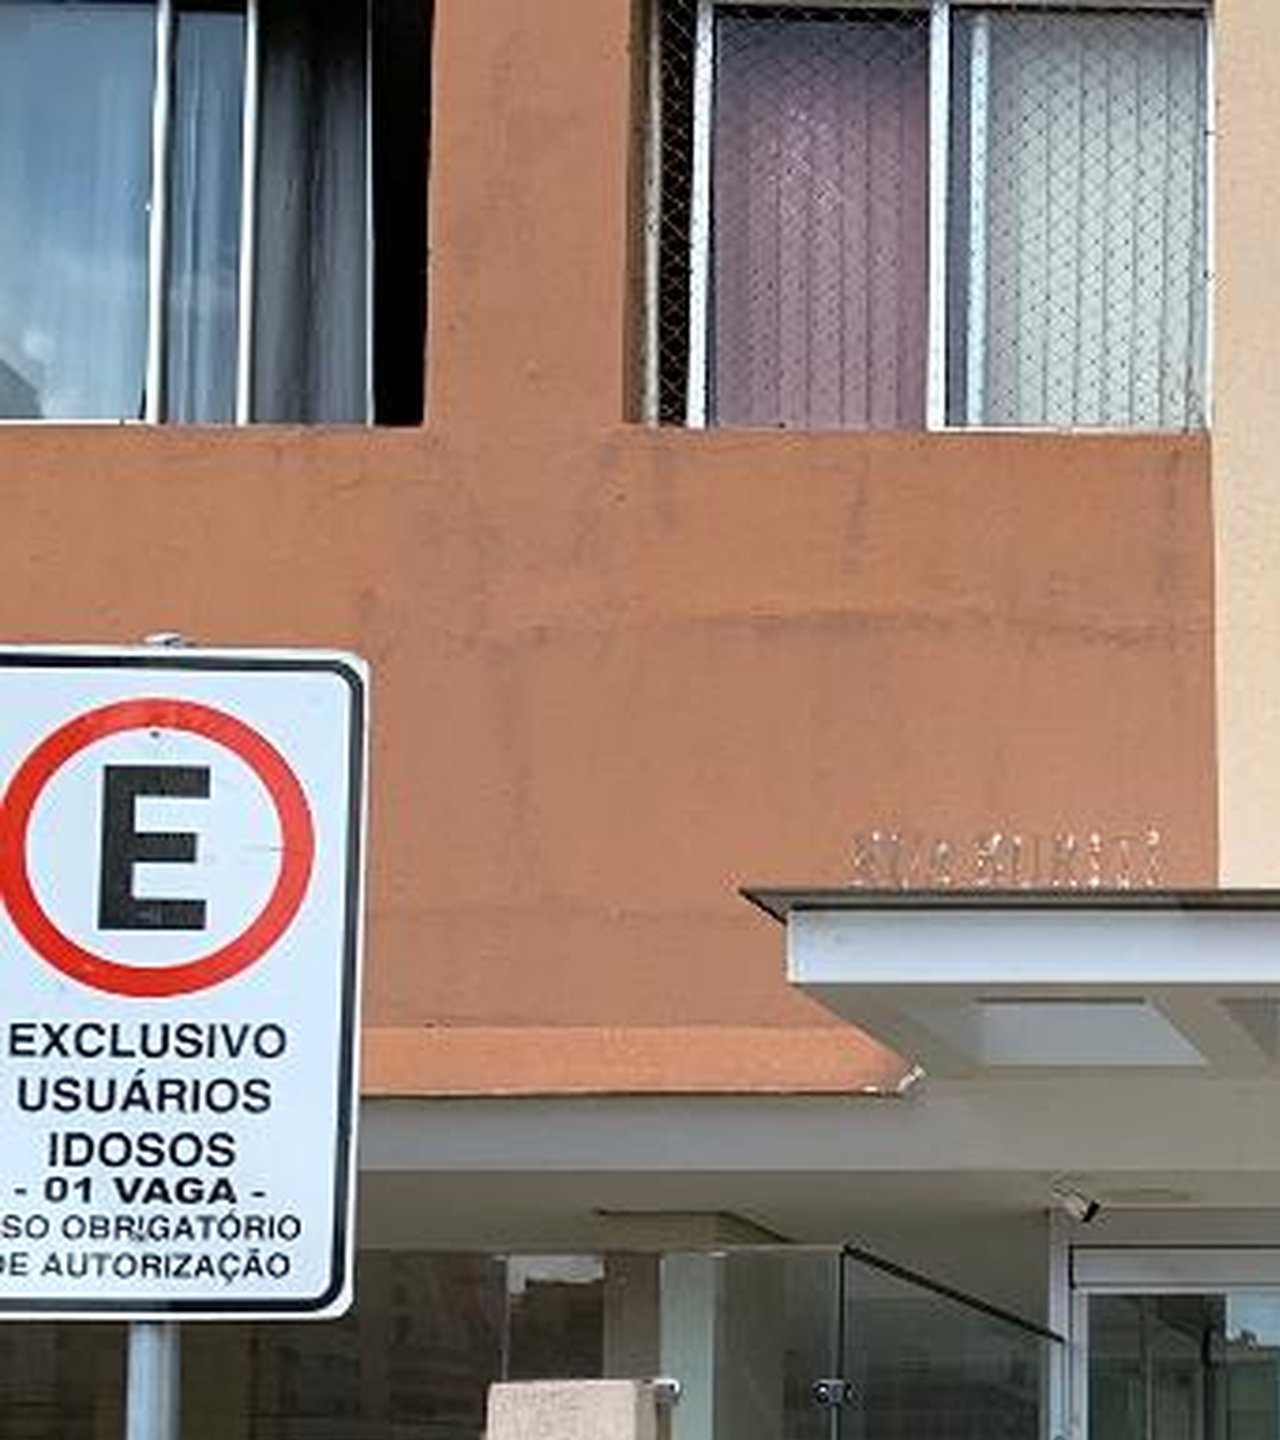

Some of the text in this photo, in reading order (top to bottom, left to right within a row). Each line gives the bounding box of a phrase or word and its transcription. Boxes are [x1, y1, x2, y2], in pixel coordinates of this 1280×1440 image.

[97, 764, 211, 931] E
[9, 1022, 287, 1058] EXCLUSIVO
[18, 1068, 272, 1113] USUÁRIOS
[48, 1131, 237, 1167] IDOSOS
[44, 1176, 92, 1203] 01
[112, 1176, 238, 1205] VAGA
[0, 1207, 302, 1242] SO OBRIGATÓRIO
[0, 1247, 291, 1286] E AUTORIZAÇÃO
